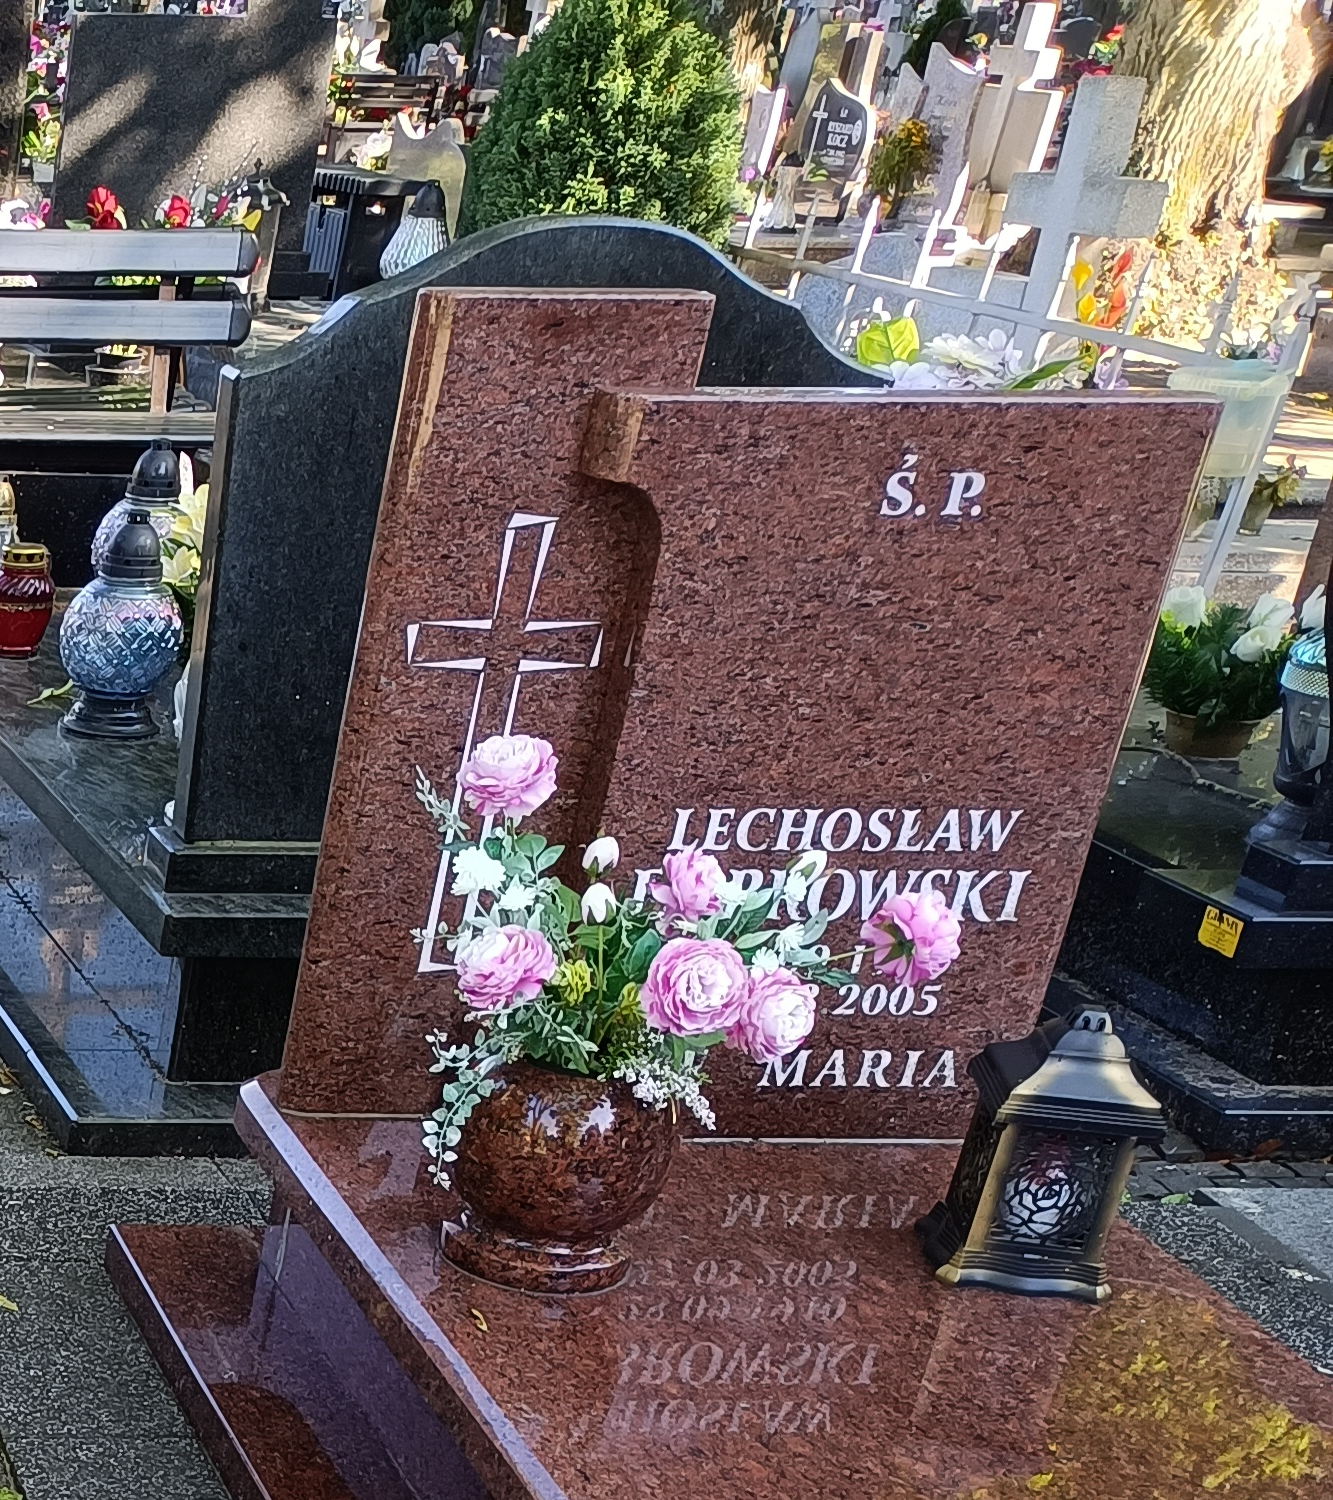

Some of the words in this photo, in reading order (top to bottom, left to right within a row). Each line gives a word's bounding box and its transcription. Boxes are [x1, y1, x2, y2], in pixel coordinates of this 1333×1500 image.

[879, 453, 926, 517] Ś.
[939, 471, 986, 517] P.
[667, 807, 1025, 853] LECHOSŁAW
[756, 1049, 959, 1089] MARIA
